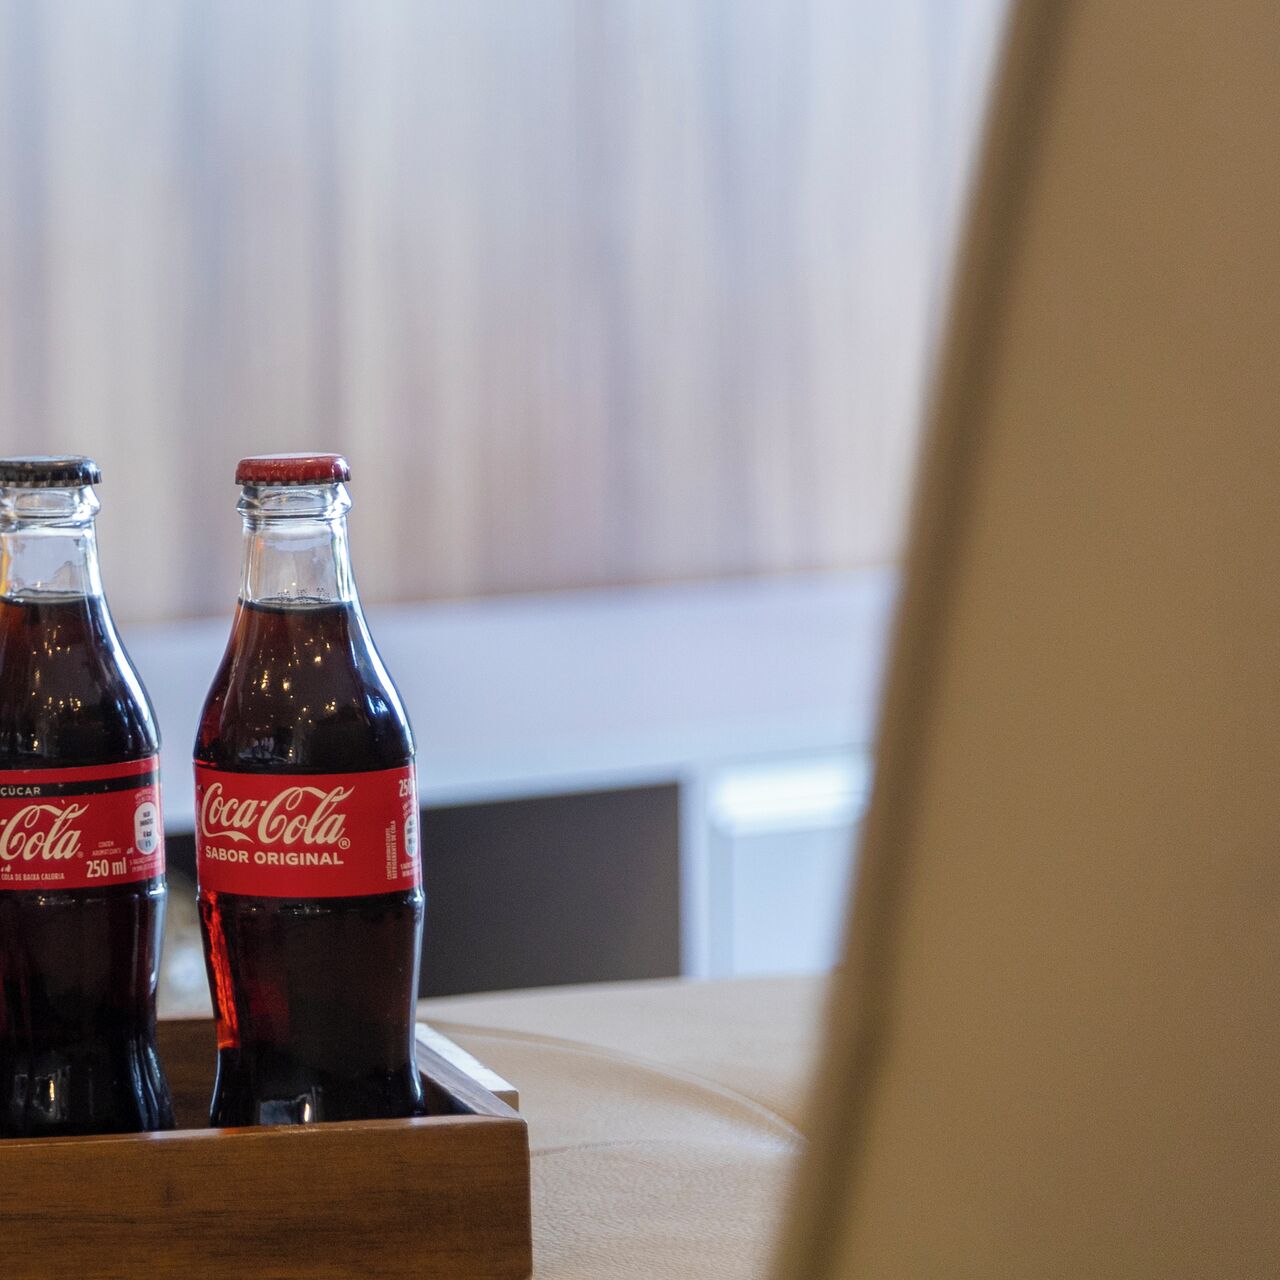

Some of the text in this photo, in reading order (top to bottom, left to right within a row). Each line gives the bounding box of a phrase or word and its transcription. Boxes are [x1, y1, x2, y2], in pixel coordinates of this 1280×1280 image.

[201, 783, 355, 845] Coca-Cola
[205, 845, 344, 866] SABOR ORIGINAL
[86, 859, 109, 878] 250
[112, 857, 127, 876] ml
